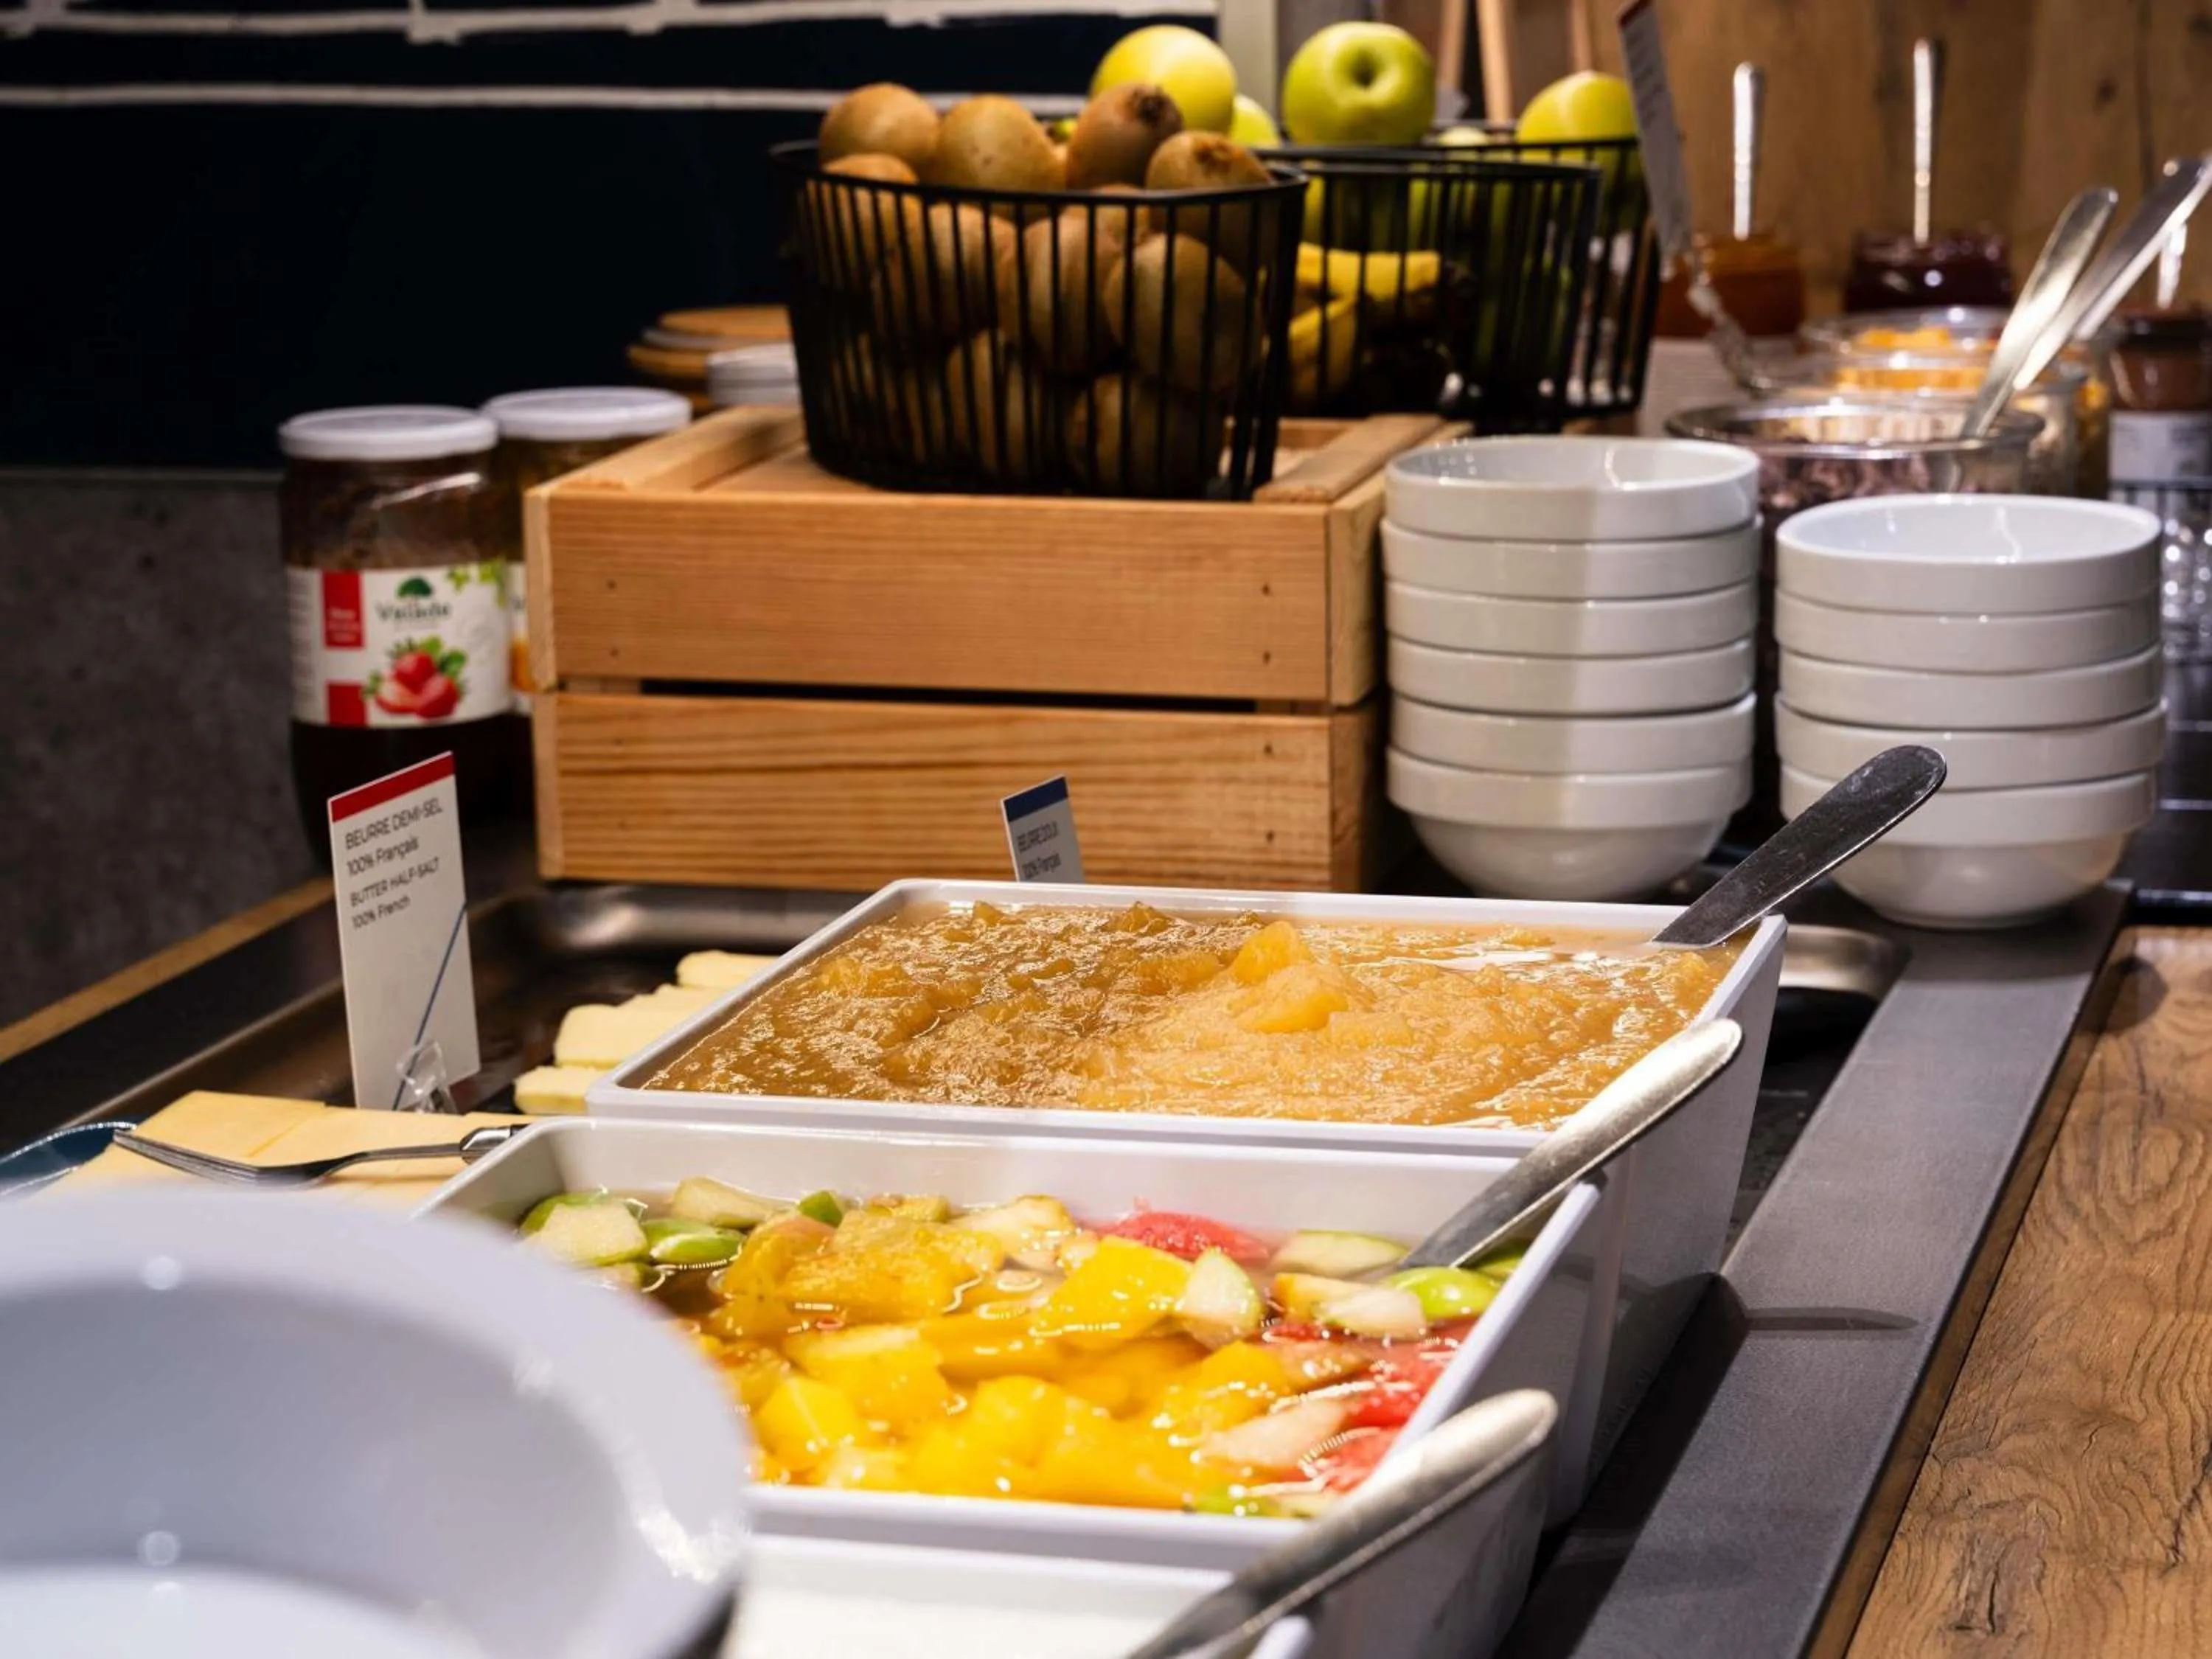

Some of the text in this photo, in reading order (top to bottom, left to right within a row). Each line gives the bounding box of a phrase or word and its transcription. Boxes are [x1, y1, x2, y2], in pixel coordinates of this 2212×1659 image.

[345, 797, 443, 849] BEURRE DEMI-SEL
[347, 835, 419, 876] 100% Français
[349, 879, 388, 907] BUTTER
[352, 894, 411, 929] 100% French
